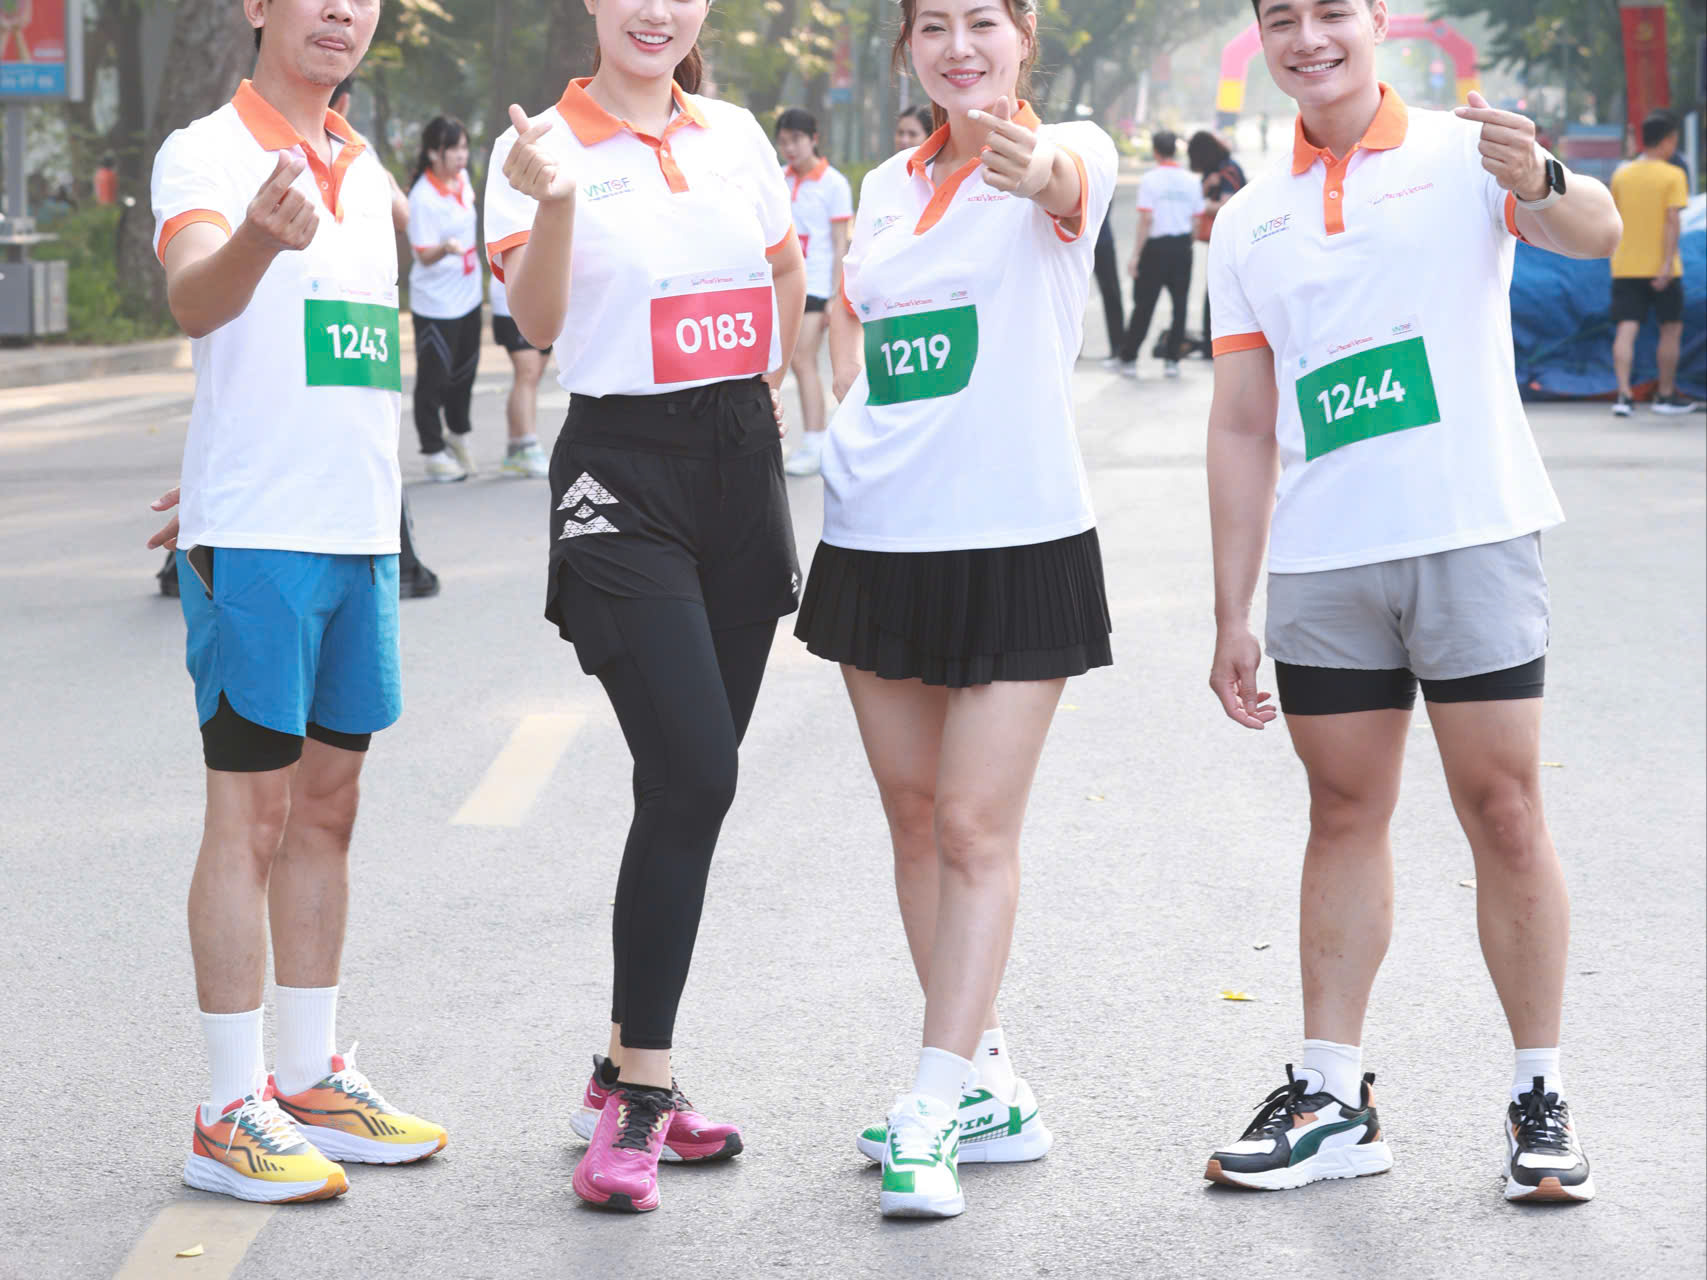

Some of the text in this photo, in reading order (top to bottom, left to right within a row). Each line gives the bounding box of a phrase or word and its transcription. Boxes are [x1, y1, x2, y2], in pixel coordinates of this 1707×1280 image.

[327, 324, 389, 362] 1243
[676, 312, 757, 354] 0183
[881, 334, 951, 376] 1219
[1317, 368, 1406, 424] 1244
